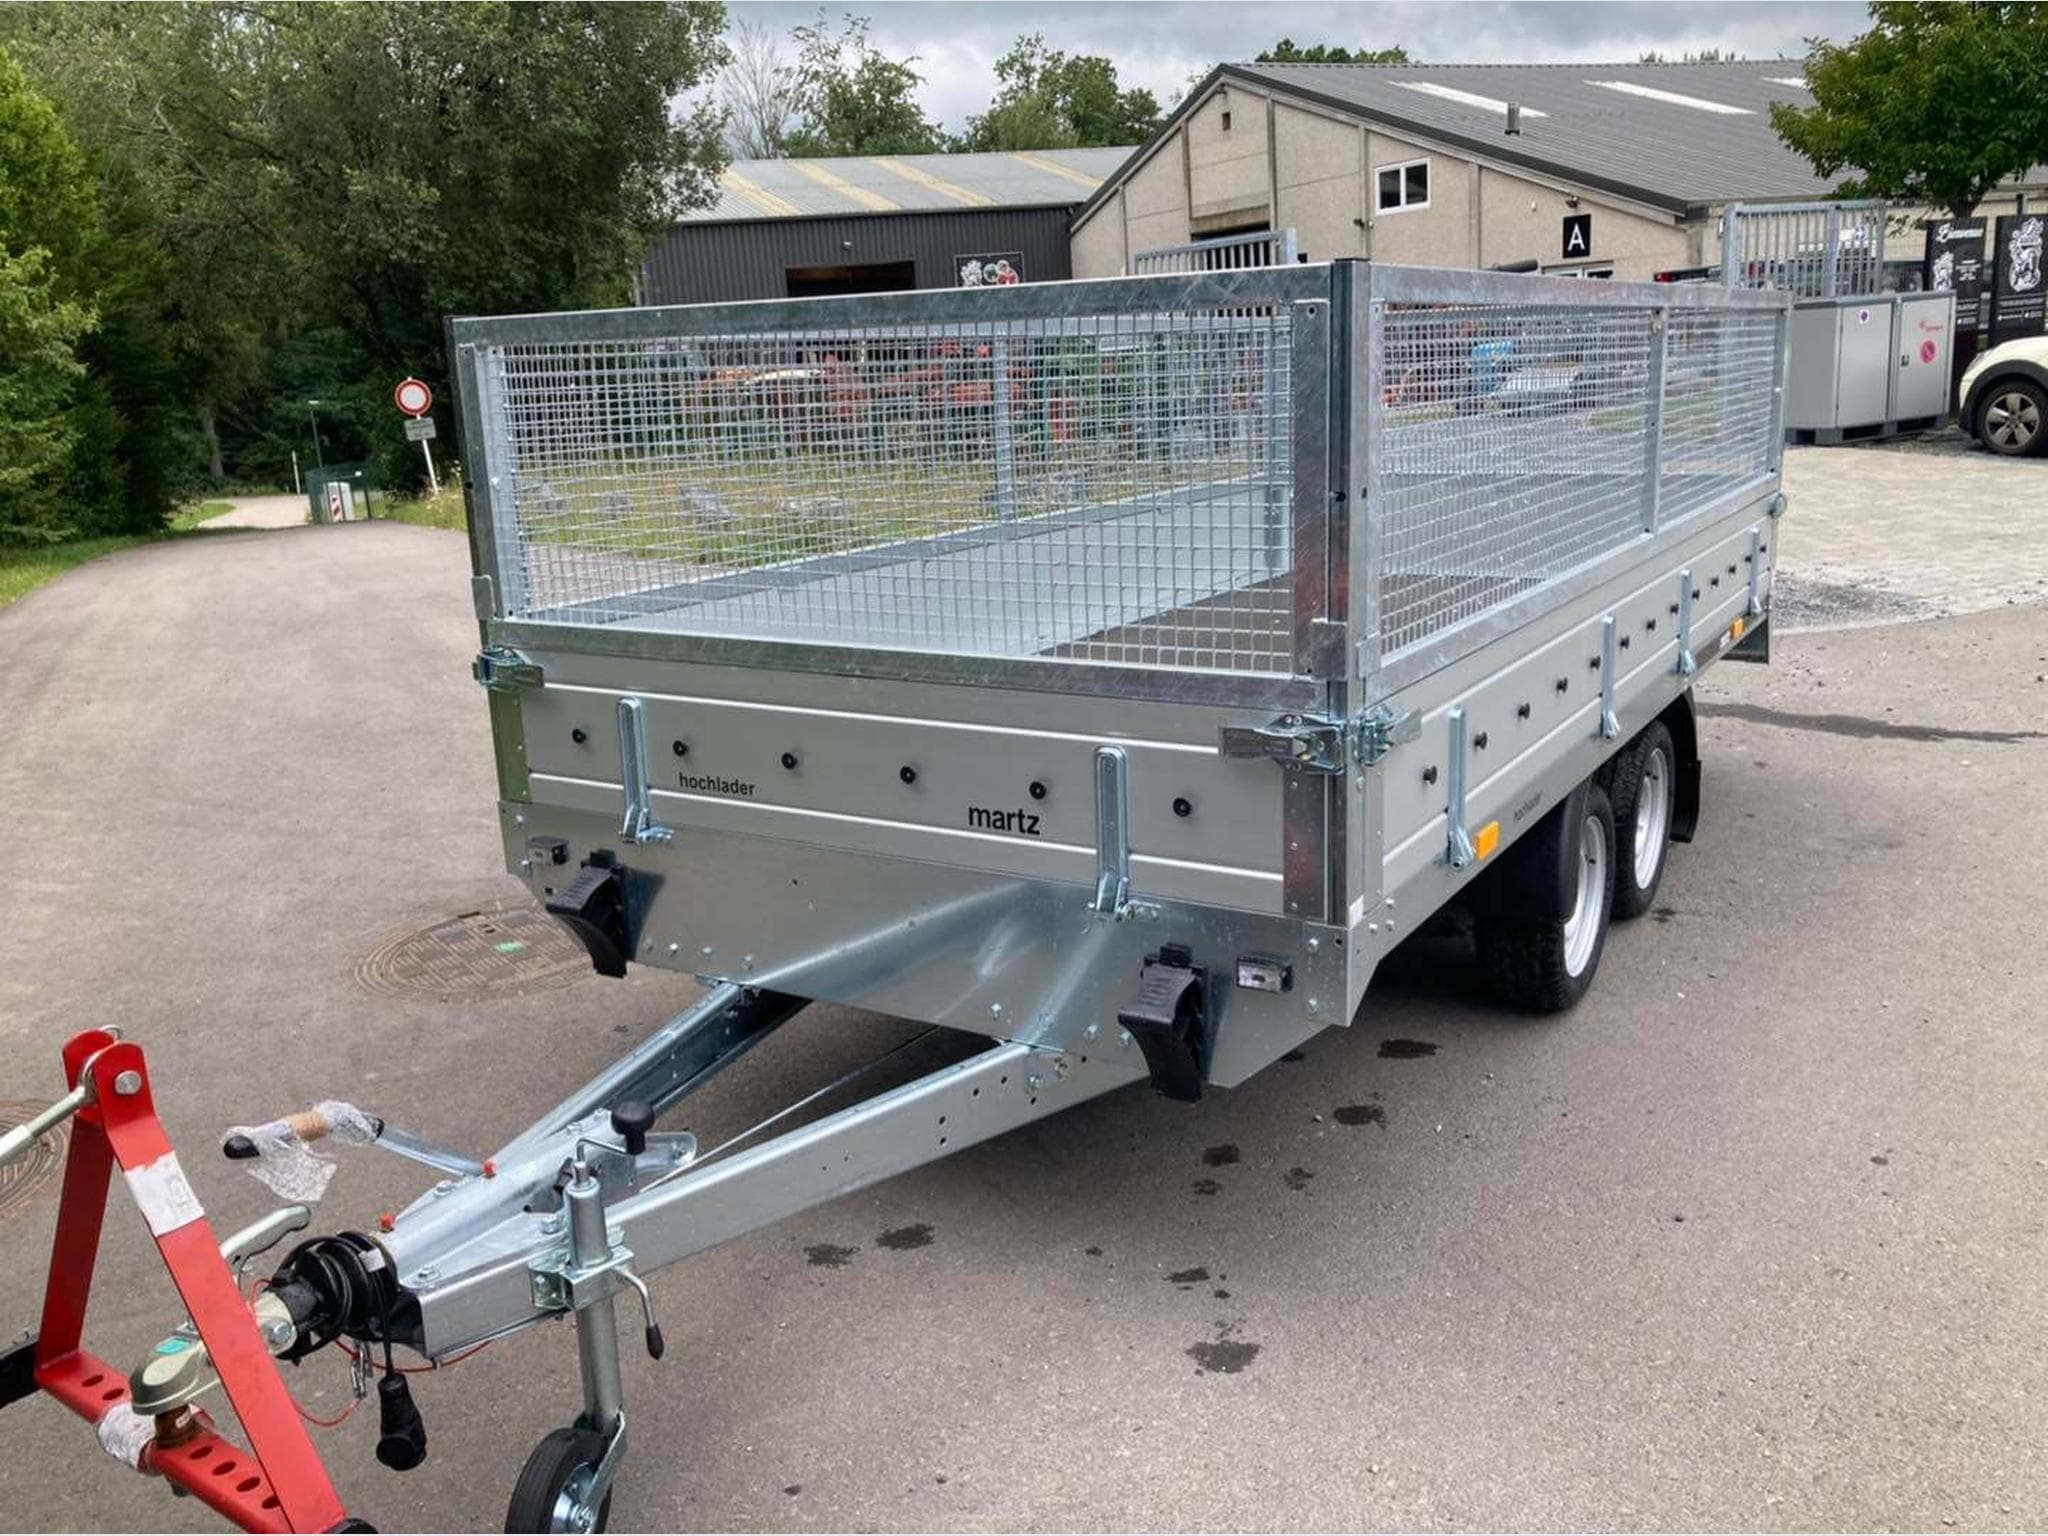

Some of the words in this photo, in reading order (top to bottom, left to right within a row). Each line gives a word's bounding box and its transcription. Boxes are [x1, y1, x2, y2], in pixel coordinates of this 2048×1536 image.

[1567, 222, 1585, 251] A
[679, 772, 755, 796] hochlader
[968, 807, 1040, 835] martz
